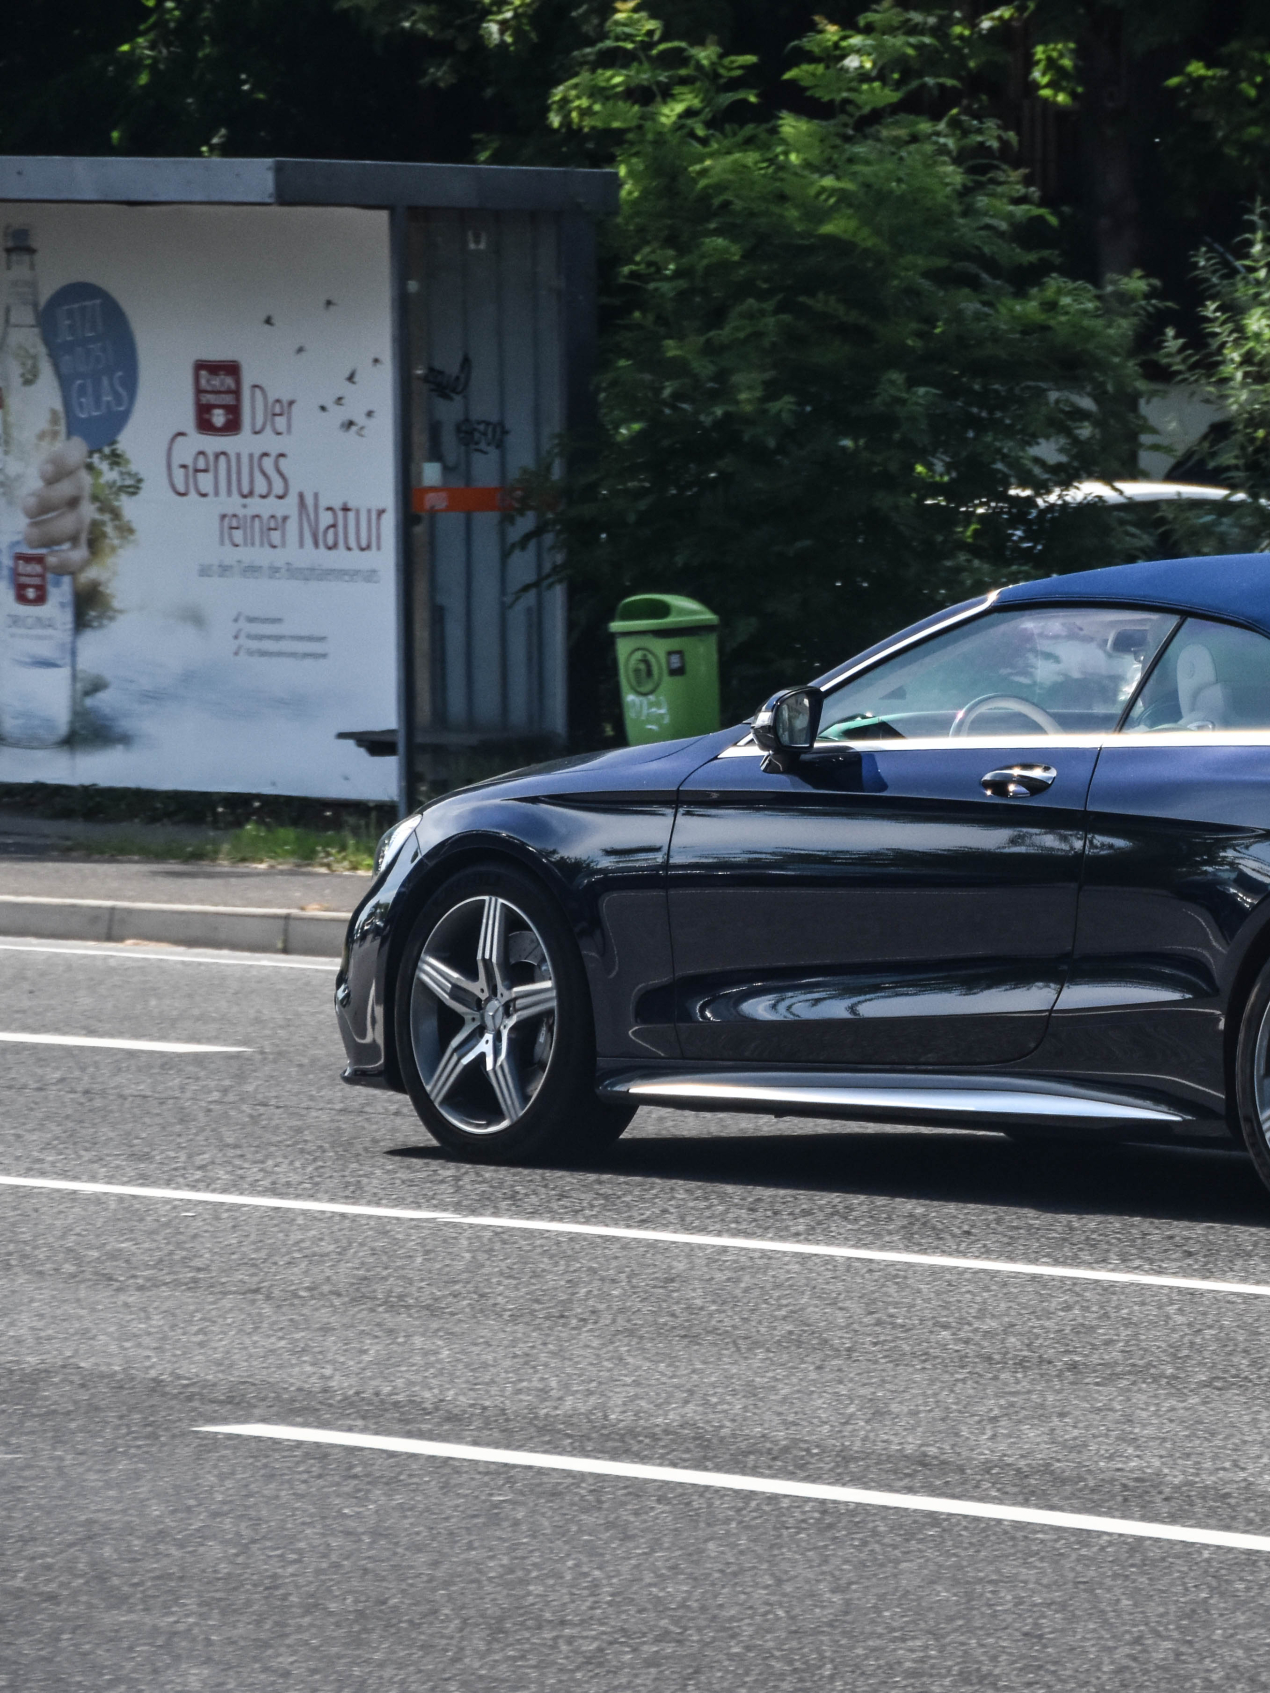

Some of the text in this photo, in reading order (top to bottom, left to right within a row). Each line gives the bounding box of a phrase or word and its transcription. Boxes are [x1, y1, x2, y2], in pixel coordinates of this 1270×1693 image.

[70, 371, 128, 418] GLAS
[251, 384, 297, 436] Der
[166, 431, 289, 499] Genuss
[219, 491, 387, 551] reiner Natur
